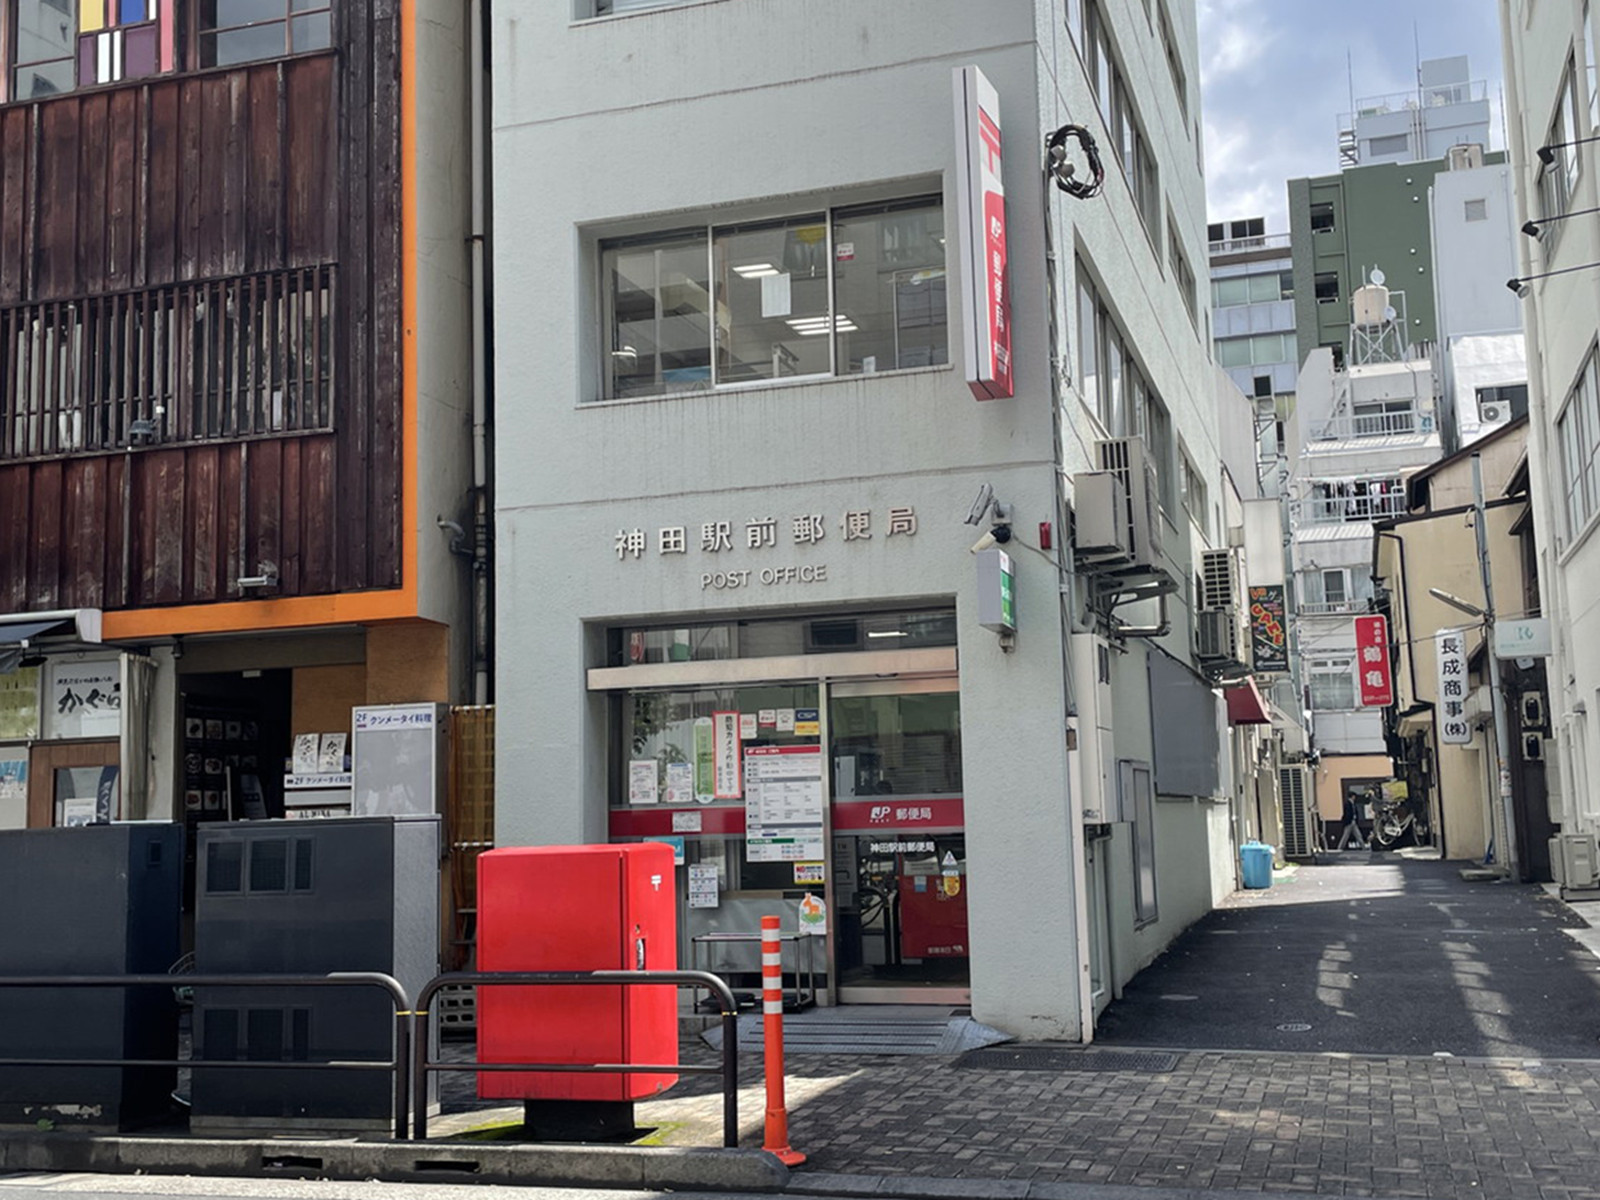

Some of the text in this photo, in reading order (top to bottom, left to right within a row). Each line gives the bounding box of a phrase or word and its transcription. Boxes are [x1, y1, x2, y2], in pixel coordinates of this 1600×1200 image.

[614, 507, 919, 559] 神田駅前郵便局
[700, 564, 827, 591] POST OFFICE
[1441, 637, 1467, 736] 長成商事(株)
[356, 713, 432, 725] 2F クンメータイ料理
[896, 807, 932, 820] 郵便局
[870, 841, 935, 853] 神田駅前郵便局
